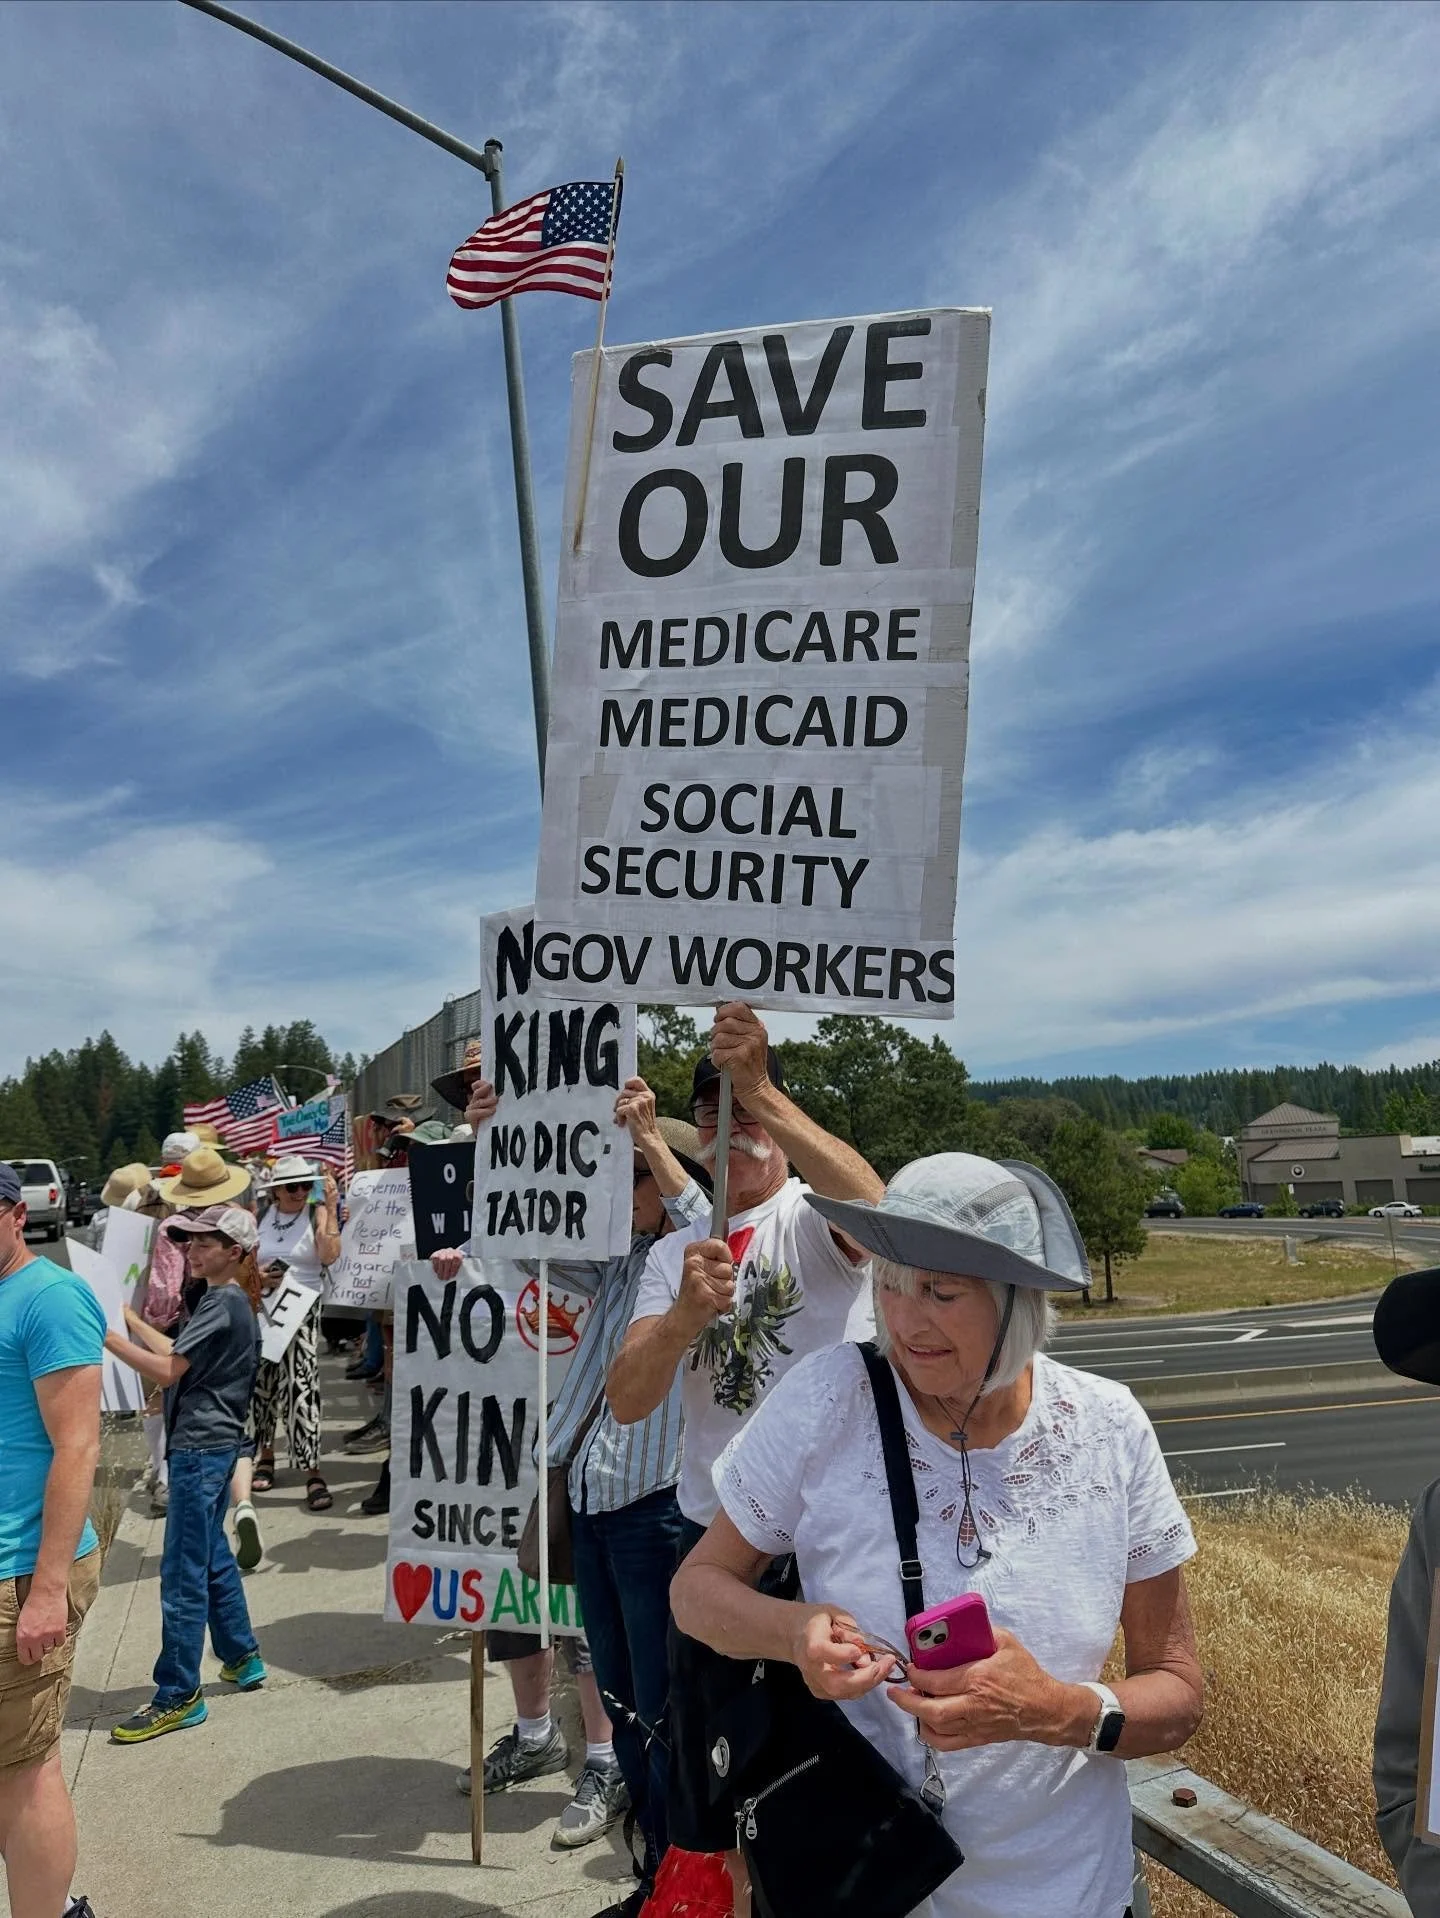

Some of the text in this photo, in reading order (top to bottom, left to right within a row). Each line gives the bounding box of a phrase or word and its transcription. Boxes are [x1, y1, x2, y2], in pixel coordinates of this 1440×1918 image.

[612, 317, 932, 453] SAVE
[618, 453, 900, 578] OUR
[599, 608, 921, 670] MEDICARE
[599, 695, 909, 748] MEDICAID
[640, 783, 857, 839] SOCIAL
[580, 845, 870, 909] SECURITY
[533, 932, 955, 1004] GOV WORKERS
[494, 1003, 621, 1100] KING
[352, 1219, 403, 1240] People
[364, 1200, 408, 1217] of the
[358, 1241, 383, 1255] not
[353, 1276, 376, 1289] not
[405, 1280, 506, 1364] NO
[410, 1384, 554, 1490] KIN
[412, 1499, 521, 1549] SINCE
[432, 1566, 486, 1624] US
